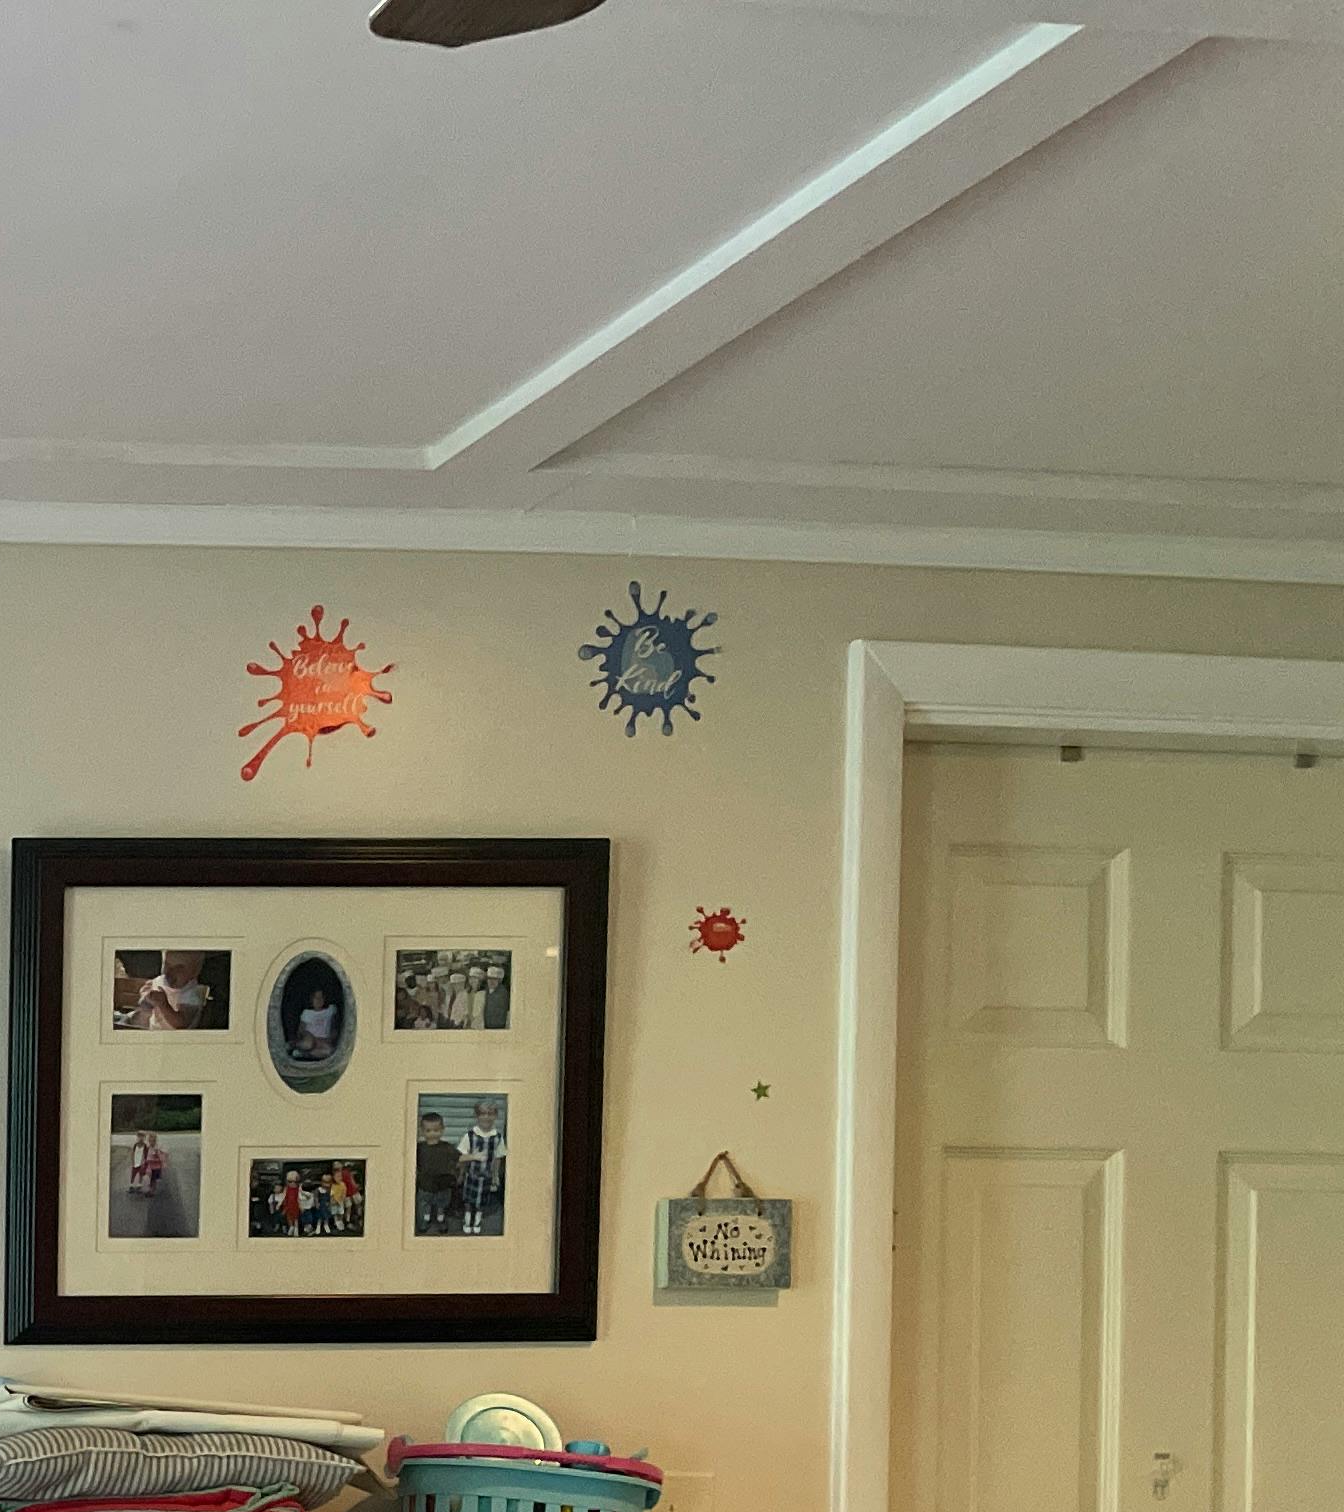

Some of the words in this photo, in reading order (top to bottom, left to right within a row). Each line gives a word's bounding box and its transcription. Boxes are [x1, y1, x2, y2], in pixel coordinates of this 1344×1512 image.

[635, 625, 667, 659] Be
[615, 664, 682, 700] Kind
[714, 1222, 741, 1240] No
[688, 1239, 767, 1266] Whining
